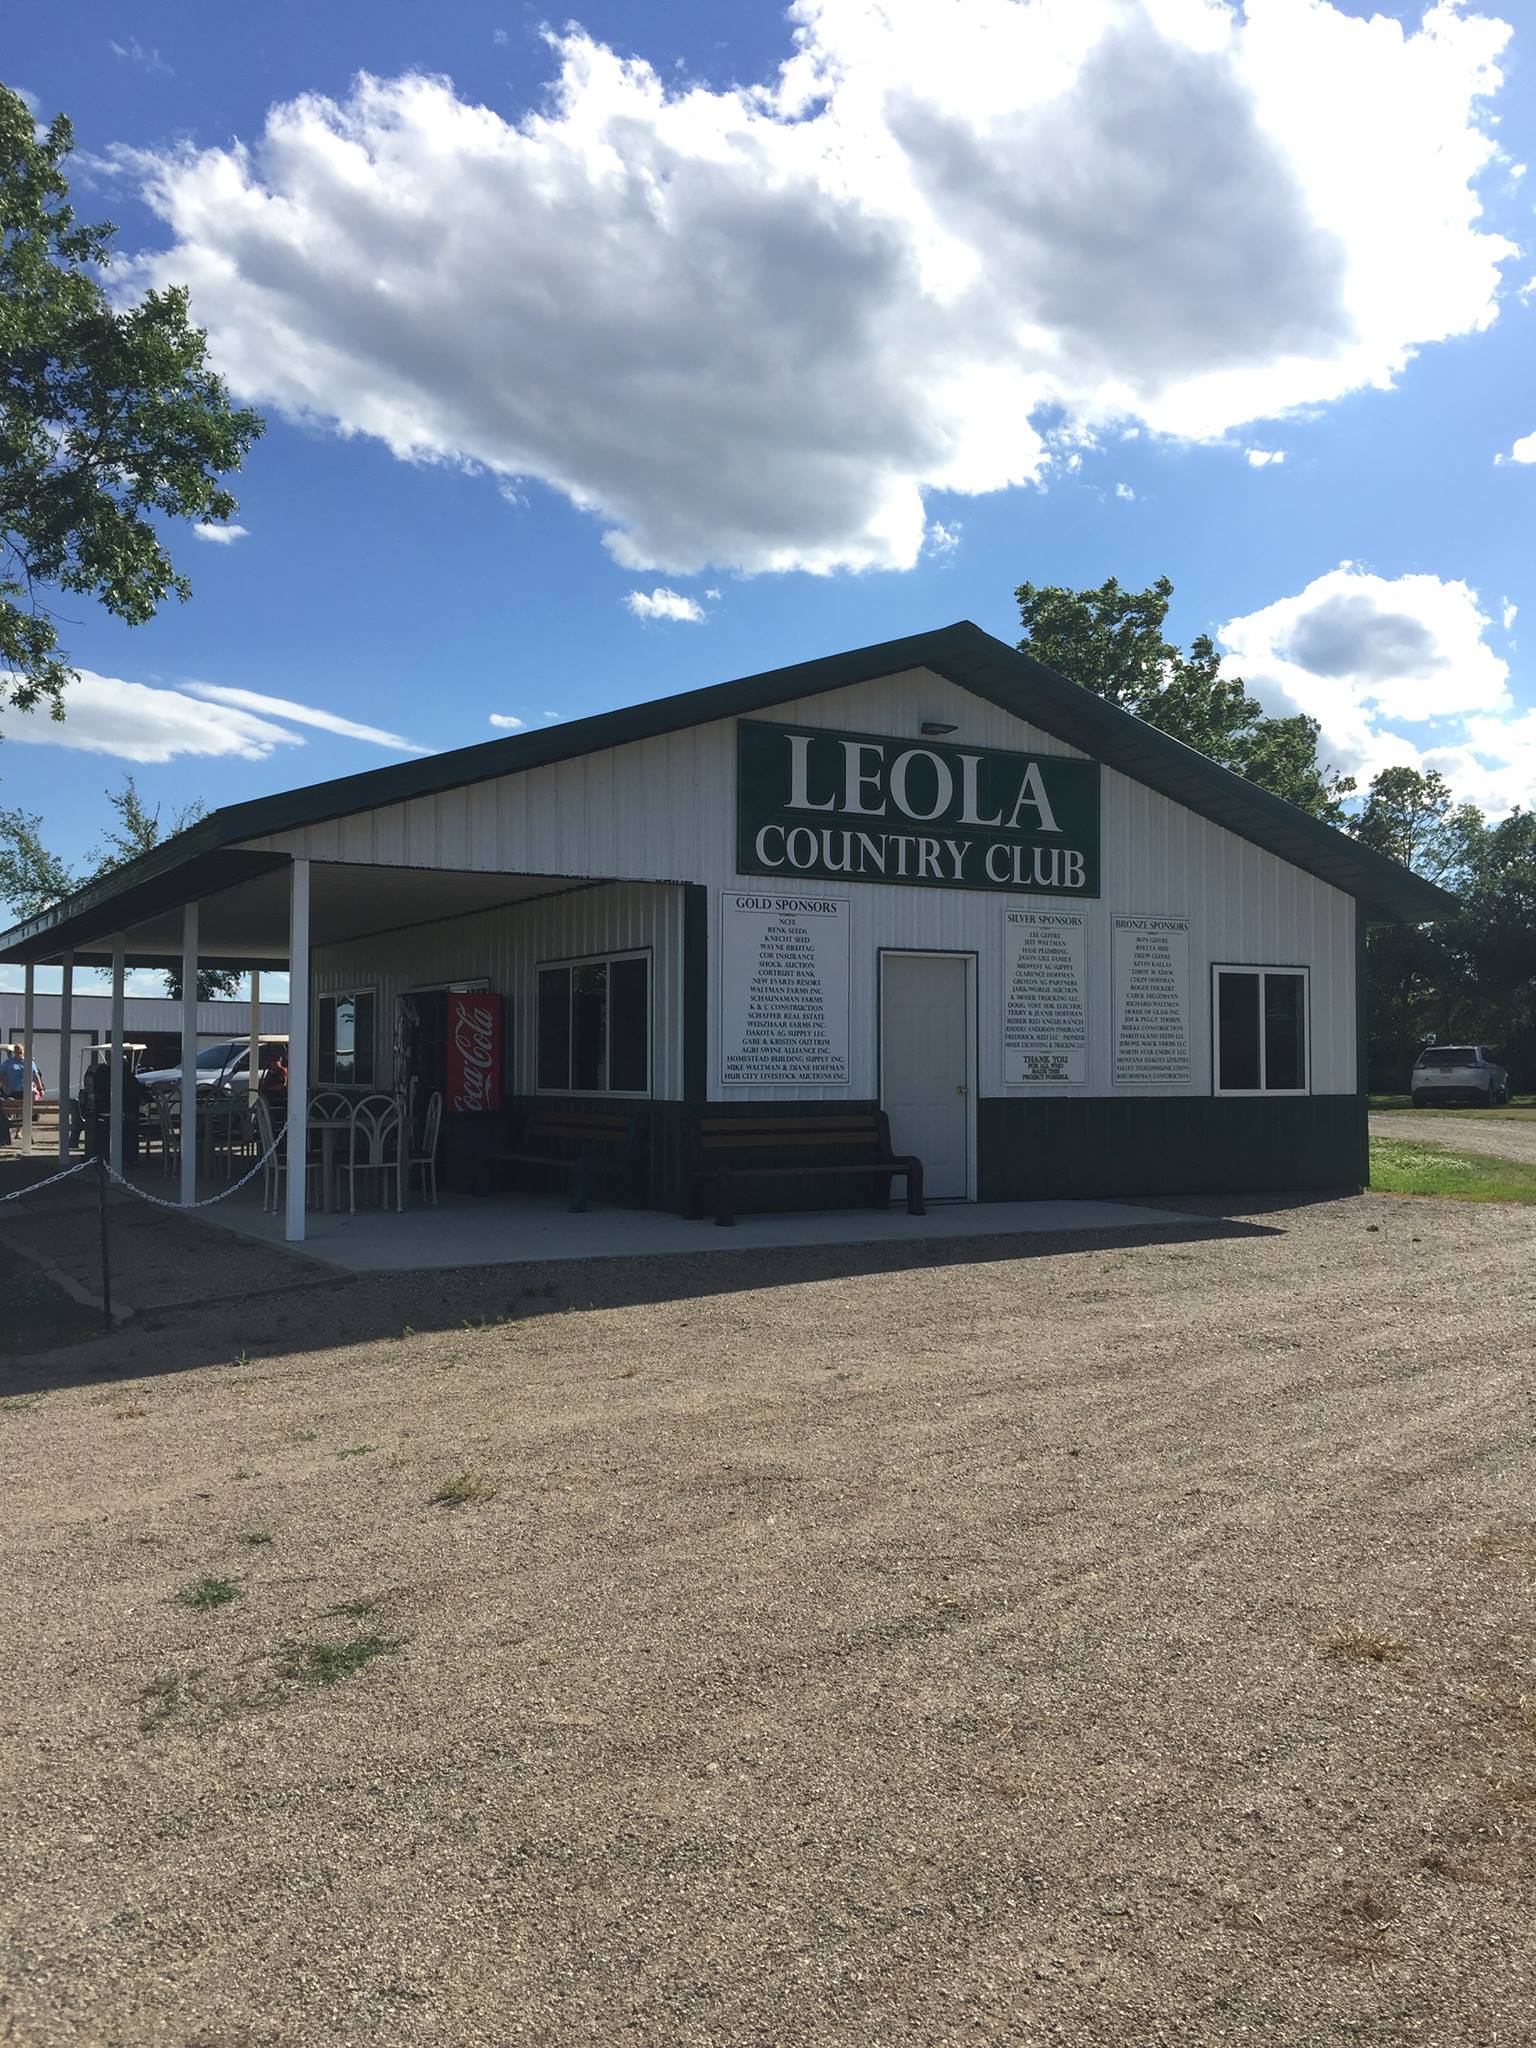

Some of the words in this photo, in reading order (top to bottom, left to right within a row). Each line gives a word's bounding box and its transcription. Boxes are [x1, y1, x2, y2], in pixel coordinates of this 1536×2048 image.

[783, 734, 1063, 832] LEOLA
[754, 824, 973, 880] COUNTRY
[984, 843, 1086, 888] CLUB
[736, 897, 771, 910] GOLD
[776, 900, 837, 913] SPONSORS
[1008, 914, 1036, 923] SILVER
[1039, 915, 1082, 926] SPONSORS
[1115, 920, 1147, 929] BRONZE
[1150, 921, 1189, 931] SPONSORS
